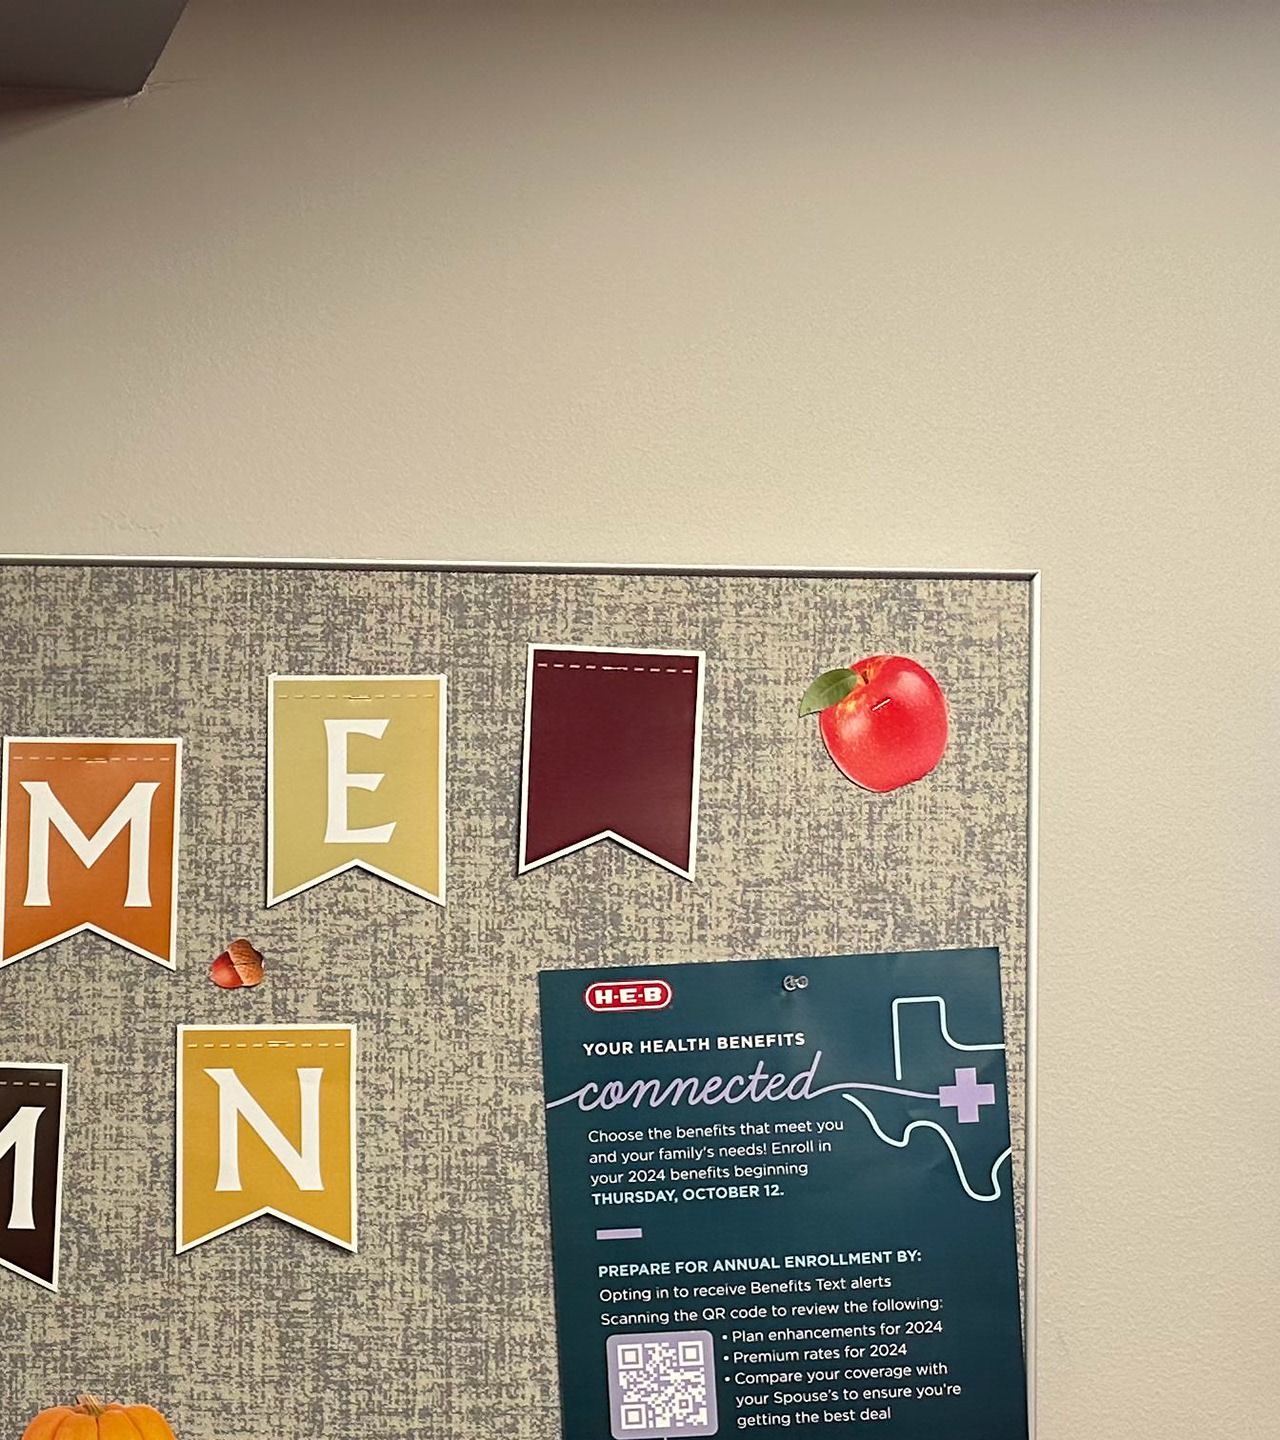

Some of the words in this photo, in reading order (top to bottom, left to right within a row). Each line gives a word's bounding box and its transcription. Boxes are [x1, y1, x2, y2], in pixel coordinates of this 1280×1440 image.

[582, 1041, 634, 1056] YOUR
[640, 1037, 710, 1054] HEALTH
[717, 1032, 805, 1050] BENEFITS
[575, 1050, 823, 1111] connected
[588, 1130, 644, 1143] Choose
[648, 1127, 672, 1140] the
[676, 1124, 736, 1139] benefits
[739, 1122, 771, 1135] that
[774, 1120, 812, 1133] meet
[816, 1121, 844, 1134] you
[590, 1173, 624, 1187] your
[628, 1169, 666, 1183] 2024
[670, 1166, 731, 1181] benefits
[733, 1164, 809, 1179] beginning
[591, 1189, 678, 1206] THURSDAY,
[682, 1185, 760, 1201] OCTOBER
[763, 1184, 785, 1197] 12.
[598, 1262, 671, 1278] PREPARE
[675, 1260, 708, 1274] FOR
[712, 1256, 781, 1272] ANNUAL
[784, 1251, 893, 1268] ENROLLMENT
[897, 1249, 922, 1263] BY:
[601, 1312, 670, 1326] Scanning
[673, 1309, 698, 1322] the
[702, 1307, 726, 1321] QR
[730, 1305, 768, 1319] code
[771, 1305, 787, 1317] to
[791, 1303, 840, 1316] review
[844, 1300, 868, 1314] the
[872, 1298, 943, 1312] following:
[732, 1330, 764, 1343] Plan
[768, 1324, 876, 1341] enhancements
[880, 1322, 901, 1335] for
[905, 1320, 943, 1334] 2024
[733, 1351, 800, 1364] Premium
[804, 1348, 841, 1360] rates
[844, 1345, 866, 1358] for
[869, 1343, 908, 1357] 2024
